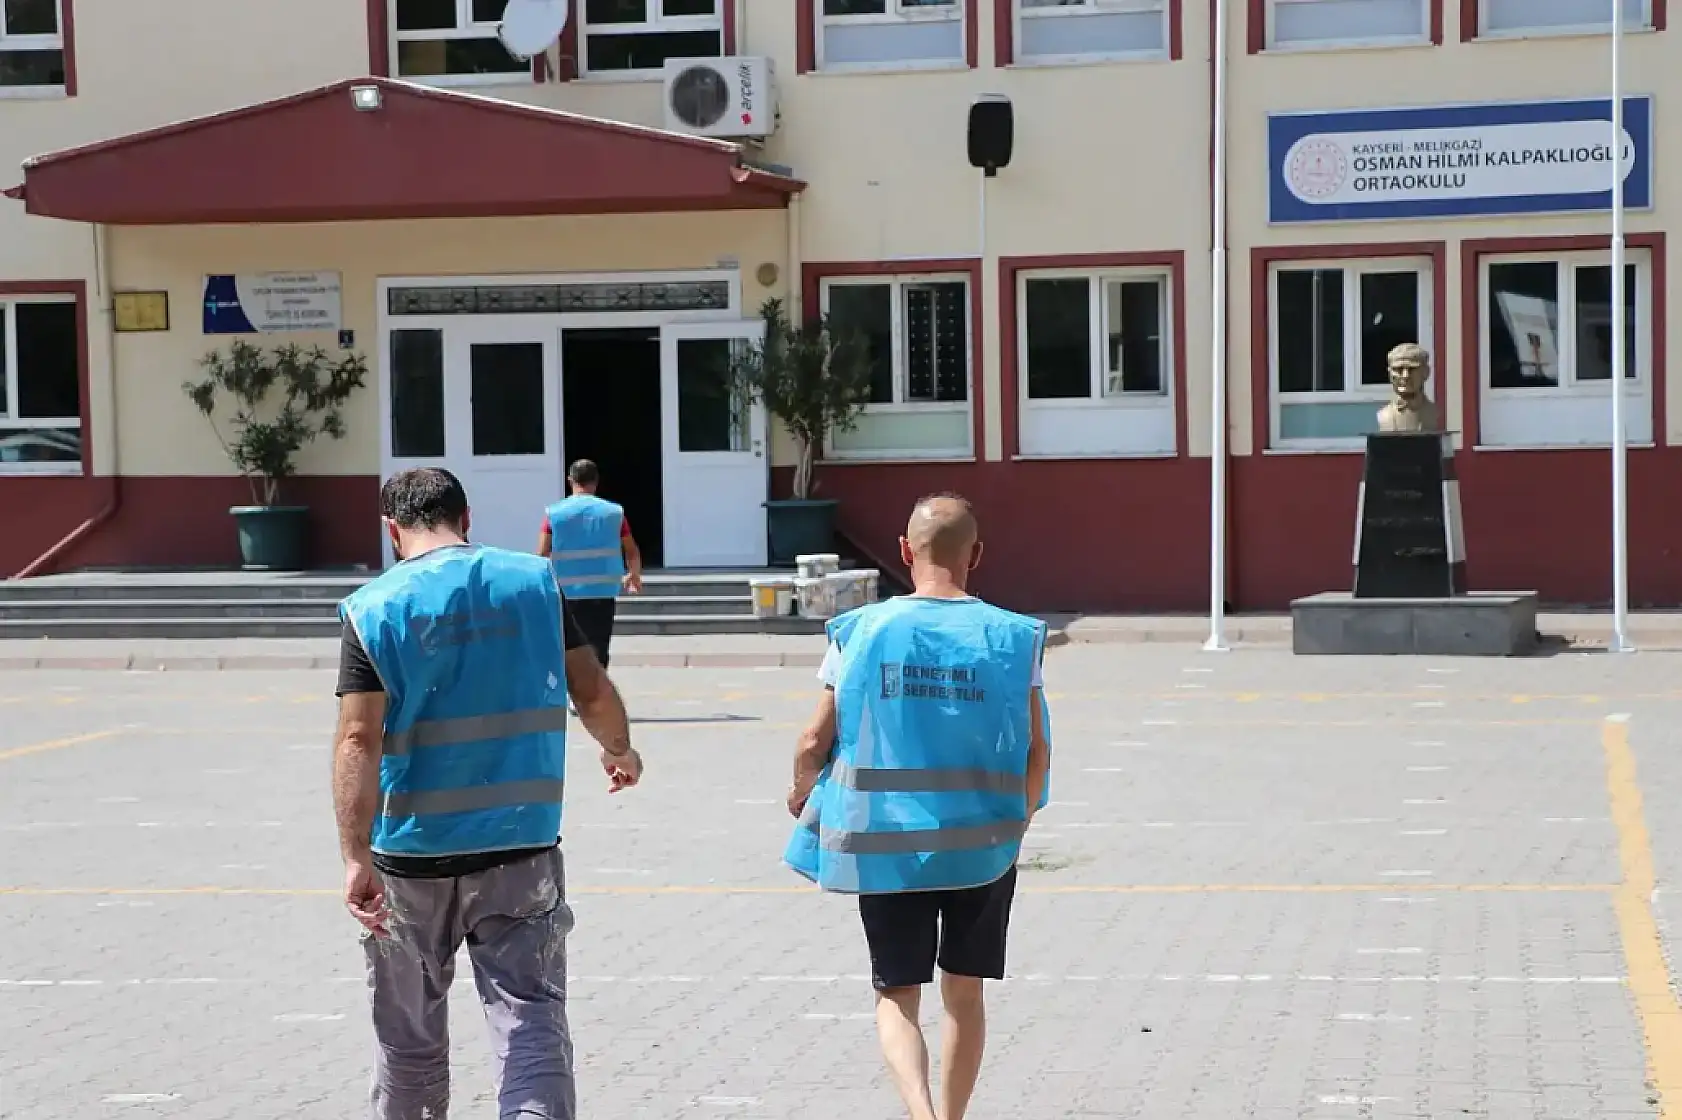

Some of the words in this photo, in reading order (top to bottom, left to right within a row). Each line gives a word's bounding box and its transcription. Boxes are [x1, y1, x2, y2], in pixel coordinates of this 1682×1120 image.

[738, 62, 754, 111] arçelik
[1352, 140, 1403, 154] KAYSERİ
[1414, 138, 1482, 152] MELİKGAZİ
[1353, 155, 1422, 172] OSMAN
[1428, 151, 1479, 169] HİLMİ
[1353, 173, 1466, 191] ORTAOKULU
